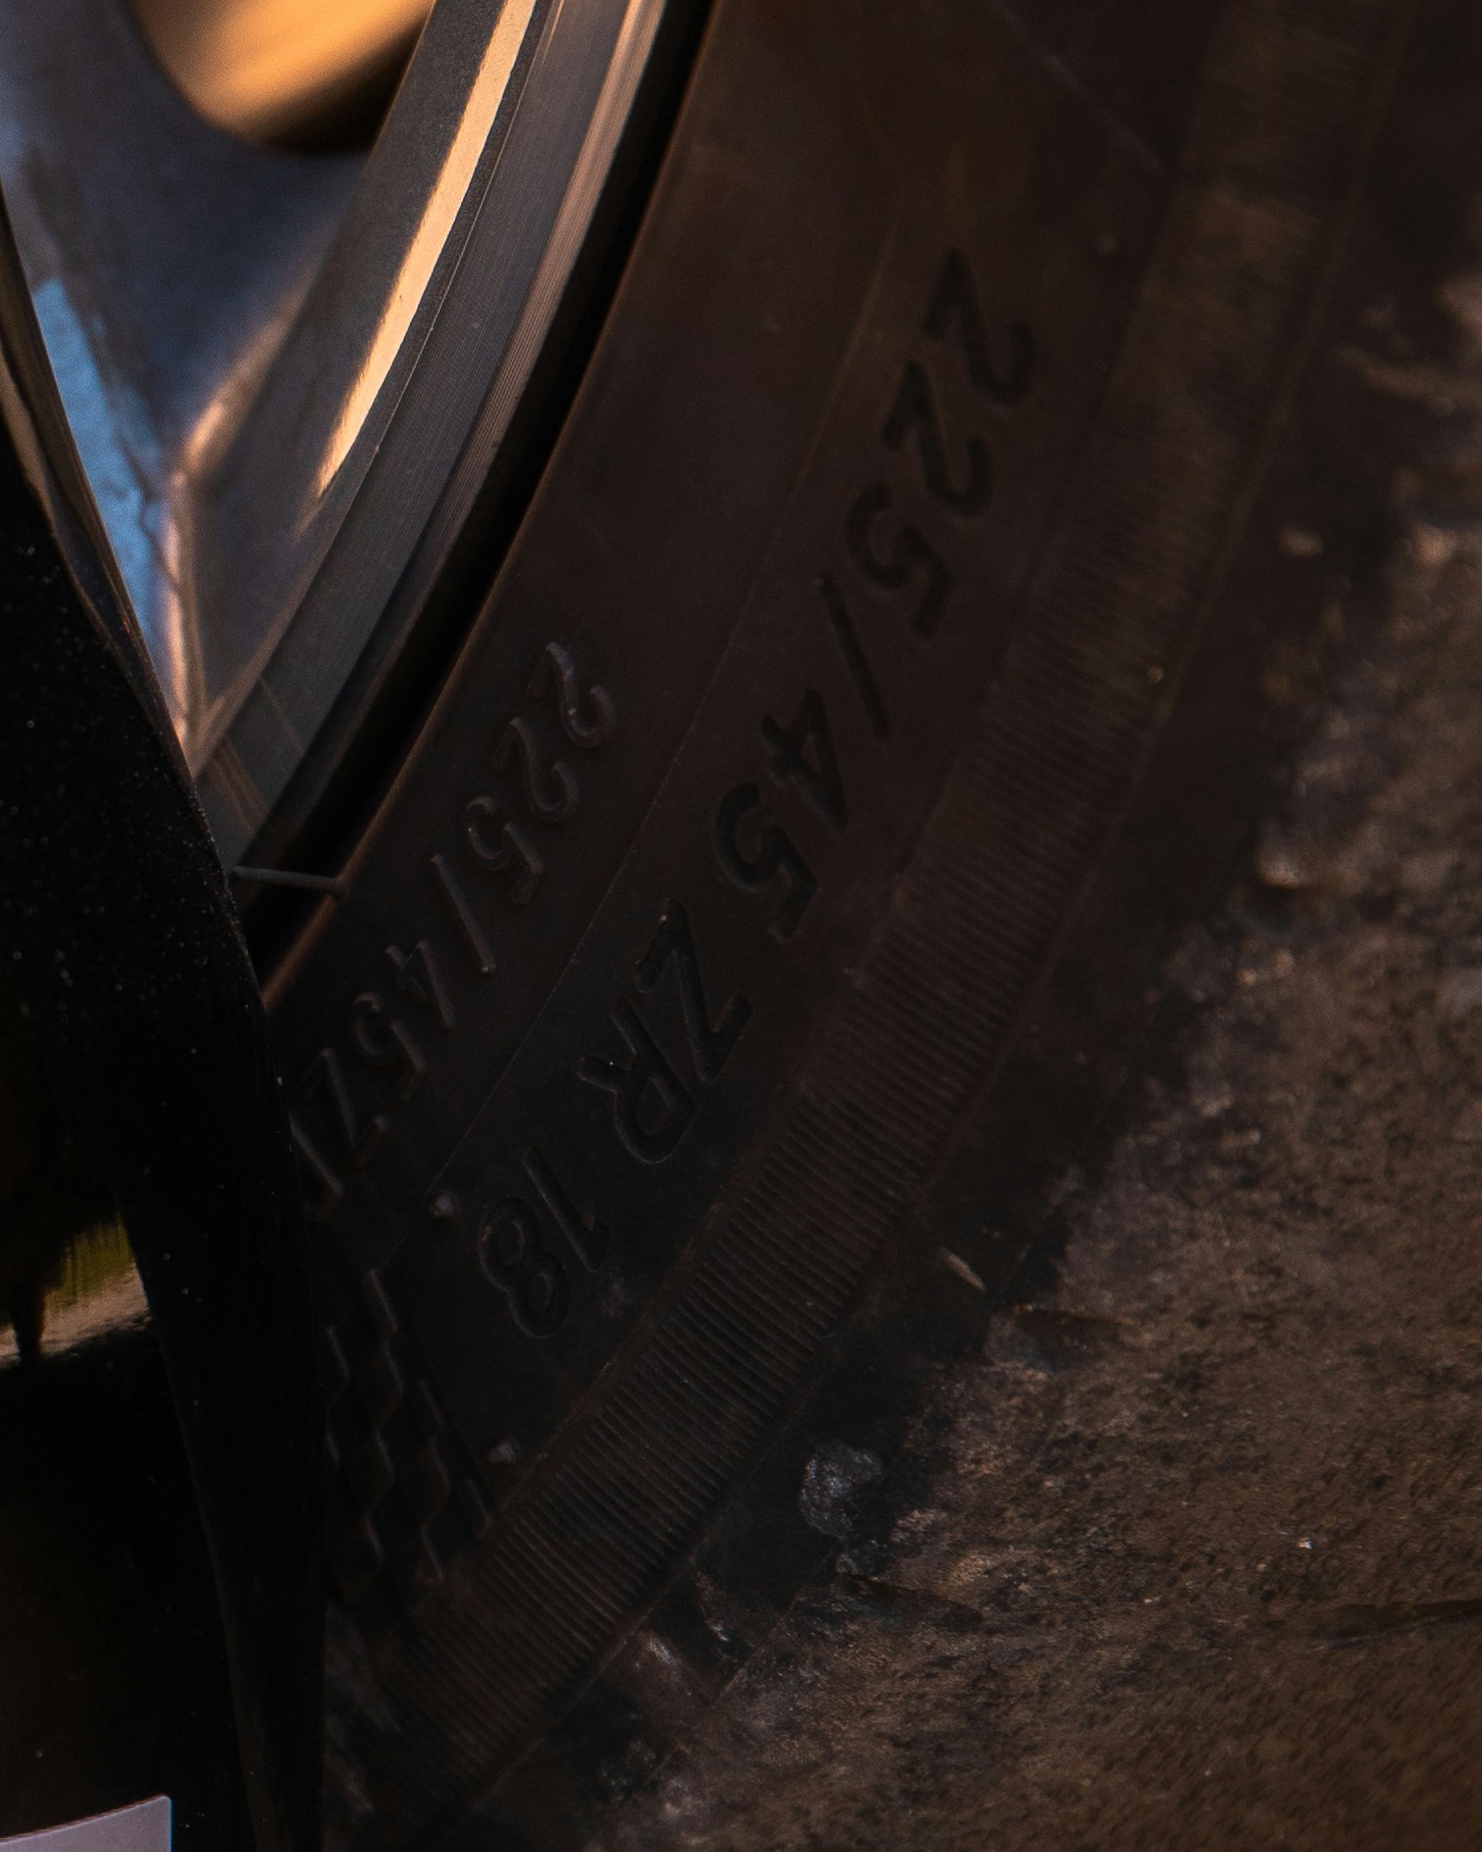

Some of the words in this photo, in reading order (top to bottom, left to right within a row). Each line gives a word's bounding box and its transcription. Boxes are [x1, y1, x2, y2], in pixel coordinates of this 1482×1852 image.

[714, 248, 1037, 947] 225/45
[575, 898, 753, 1166] ZR
[475, 1146, 613, 1343] 18
